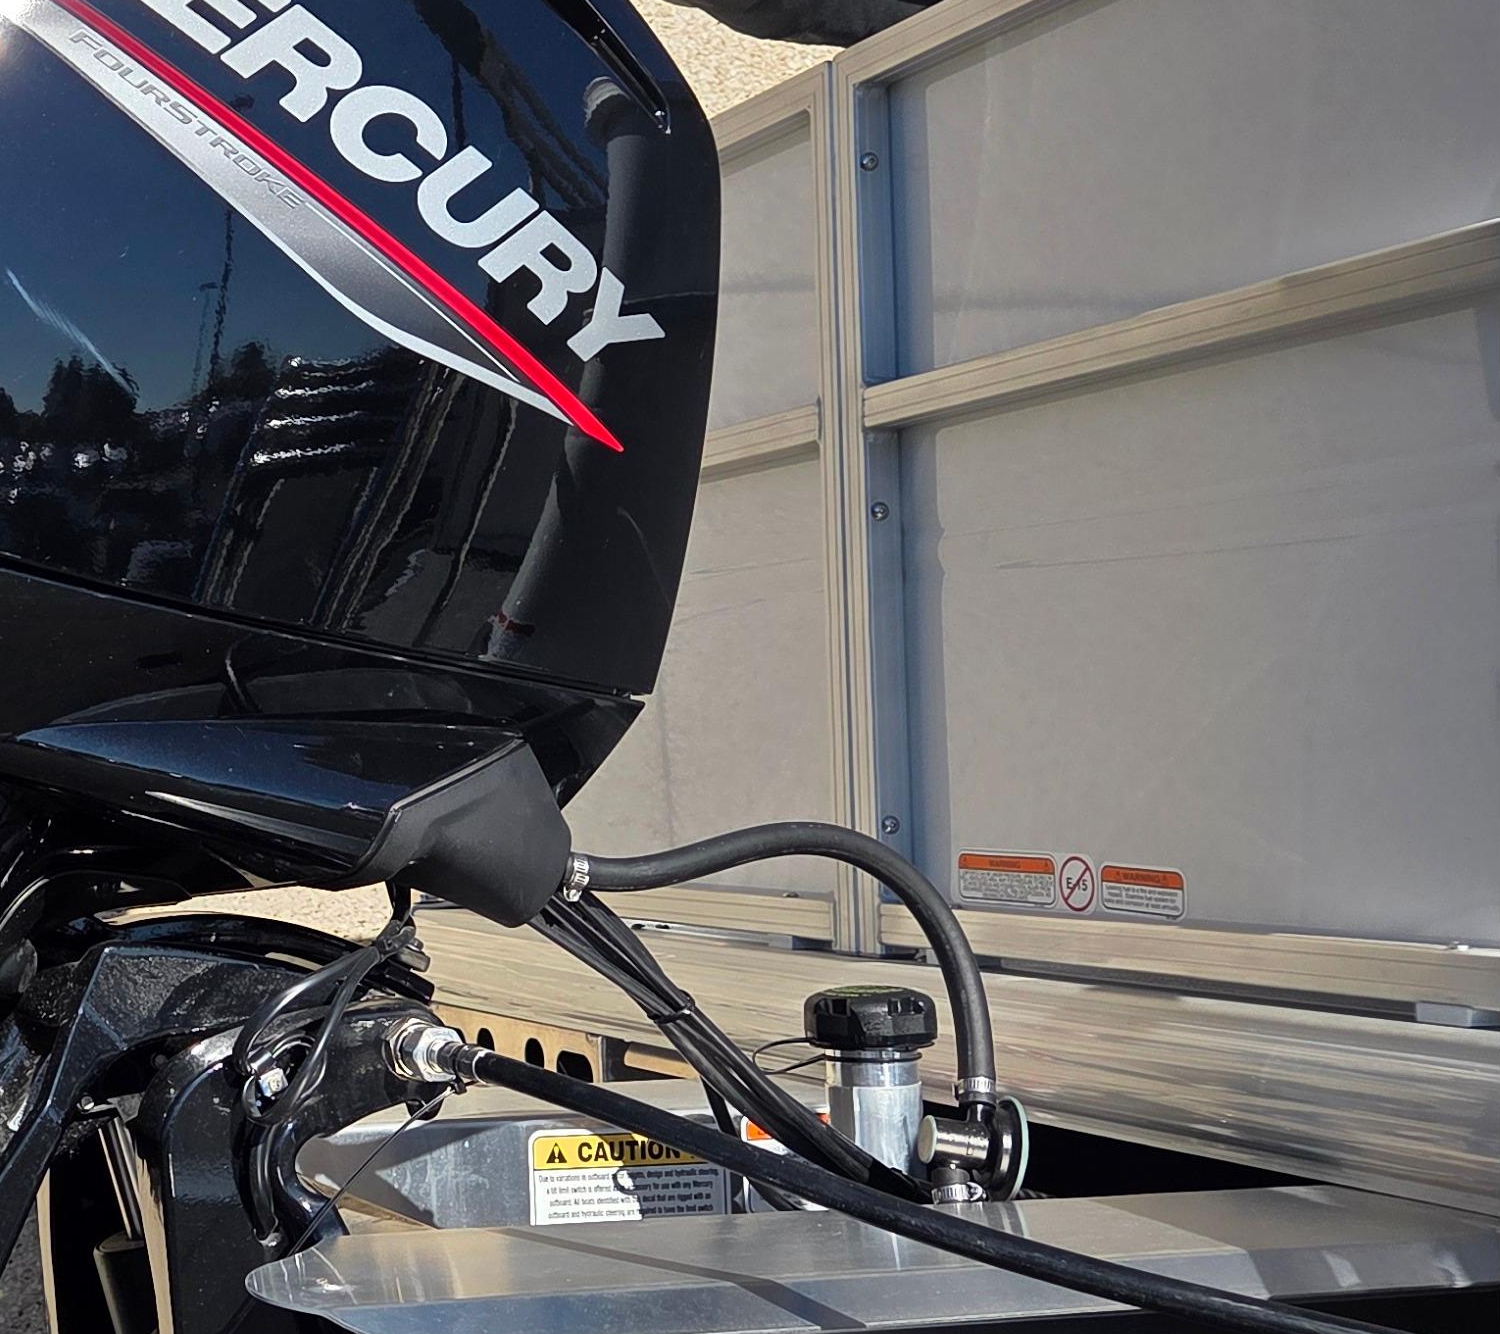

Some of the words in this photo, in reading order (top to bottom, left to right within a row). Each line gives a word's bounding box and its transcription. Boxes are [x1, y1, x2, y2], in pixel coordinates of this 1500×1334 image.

[67, 28, 308, 210] FOURSTROKE
[1121, 871, 1161, 884] WARNING
[577, 1139, 681, 1163] CAUTION
